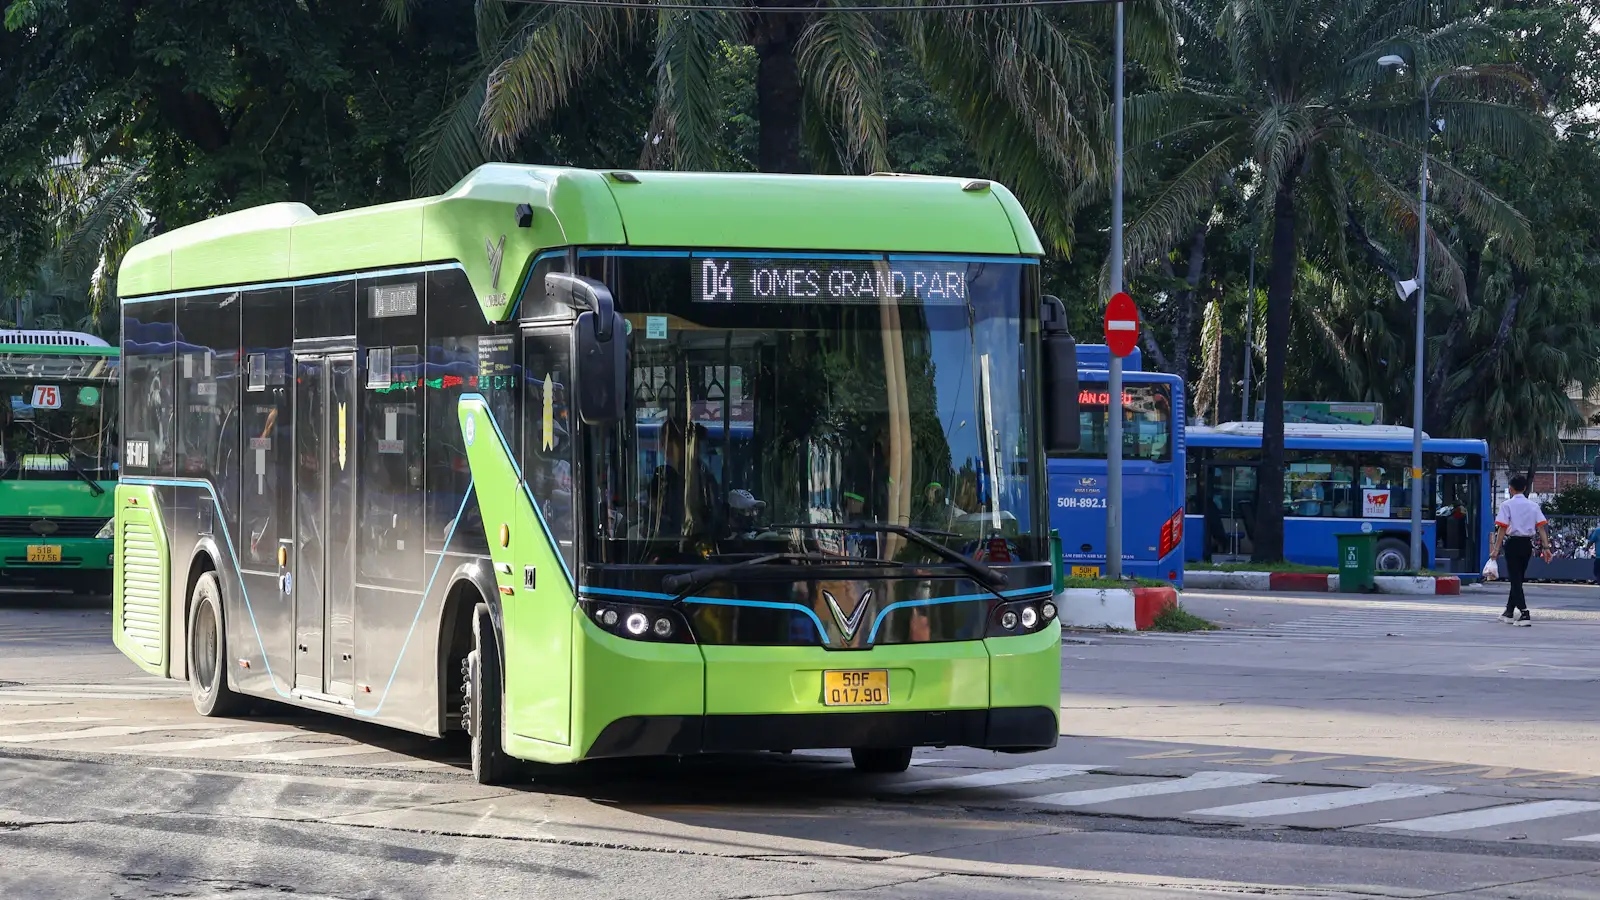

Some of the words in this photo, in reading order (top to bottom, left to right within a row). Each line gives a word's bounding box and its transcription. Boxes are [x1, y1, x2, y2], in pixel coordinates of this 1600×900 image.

[702, 260, 733, 300] D4
[828, 270, 906, 297] GRAND
[38, 386, 56, 406] 75
[1057, 497, 1107, 508] 50H-892.1
[37, 546, 52, 554] 51B
[843, 672, 870, 686] 50F
[832, 688, 882, 703] 017.90
